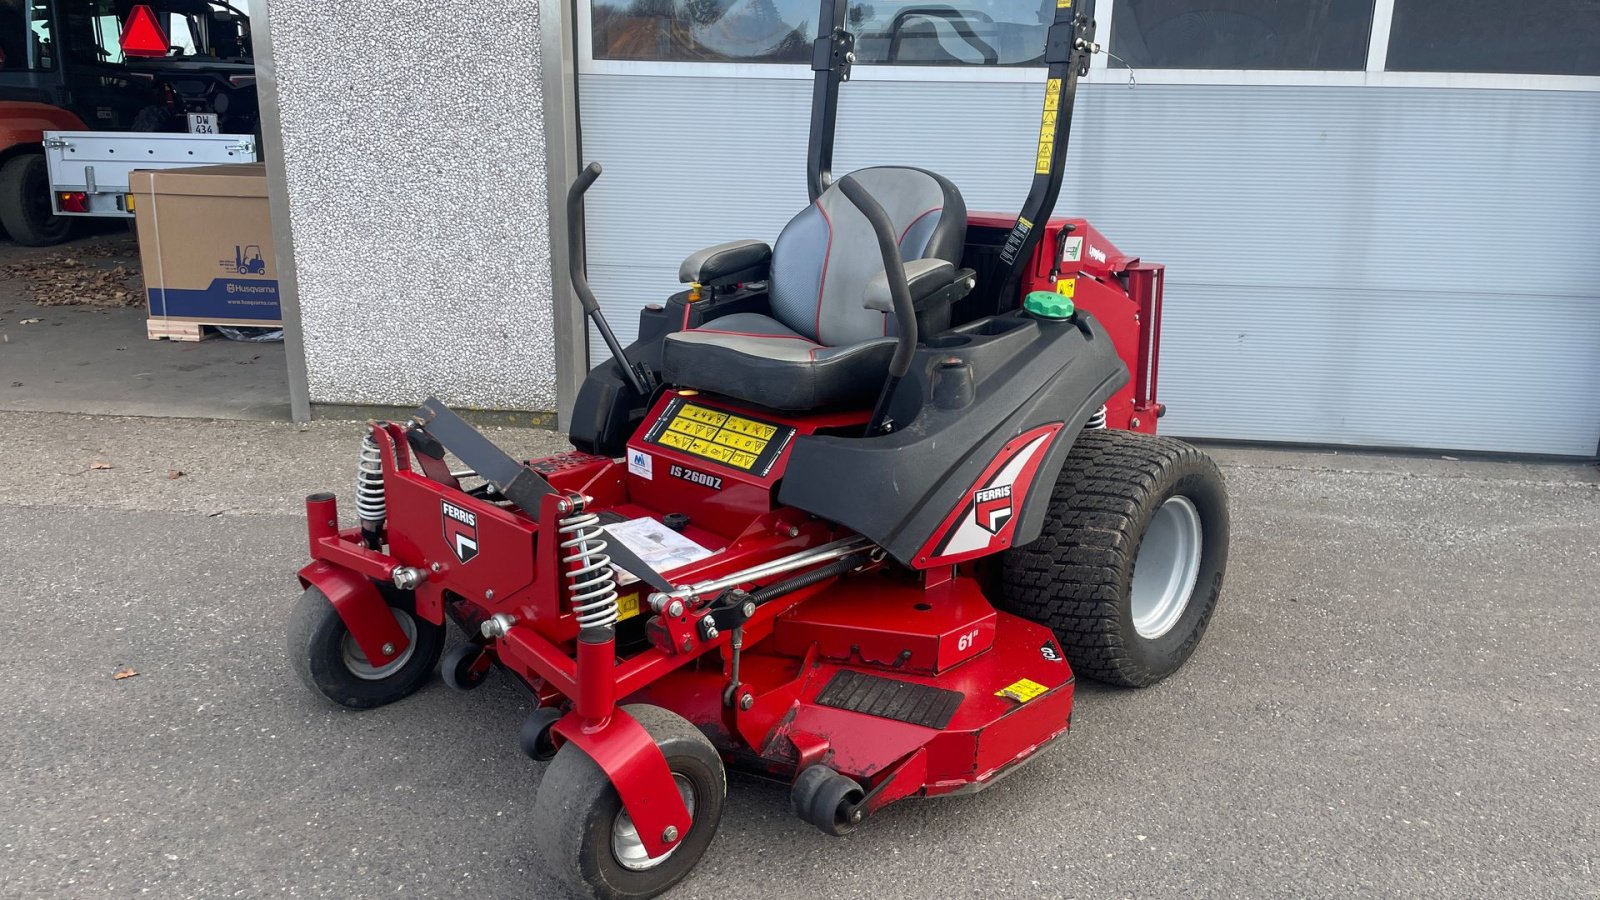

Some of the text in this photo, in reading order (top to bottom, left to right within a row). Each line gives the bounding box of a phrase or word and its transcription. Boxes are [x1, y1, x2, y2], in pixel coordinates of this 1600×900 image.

[196, 115, 209, 125] DW
[195, 124, 213, 134] 434
[235, 284, 276, 294] Husqvarna
[670, 464, 683, 477] IS
[683, 469, 722, 490] 2600Z
[976, 486, 1011, 503] FERRIS
[443, 503, 475, 527] FERRIS
